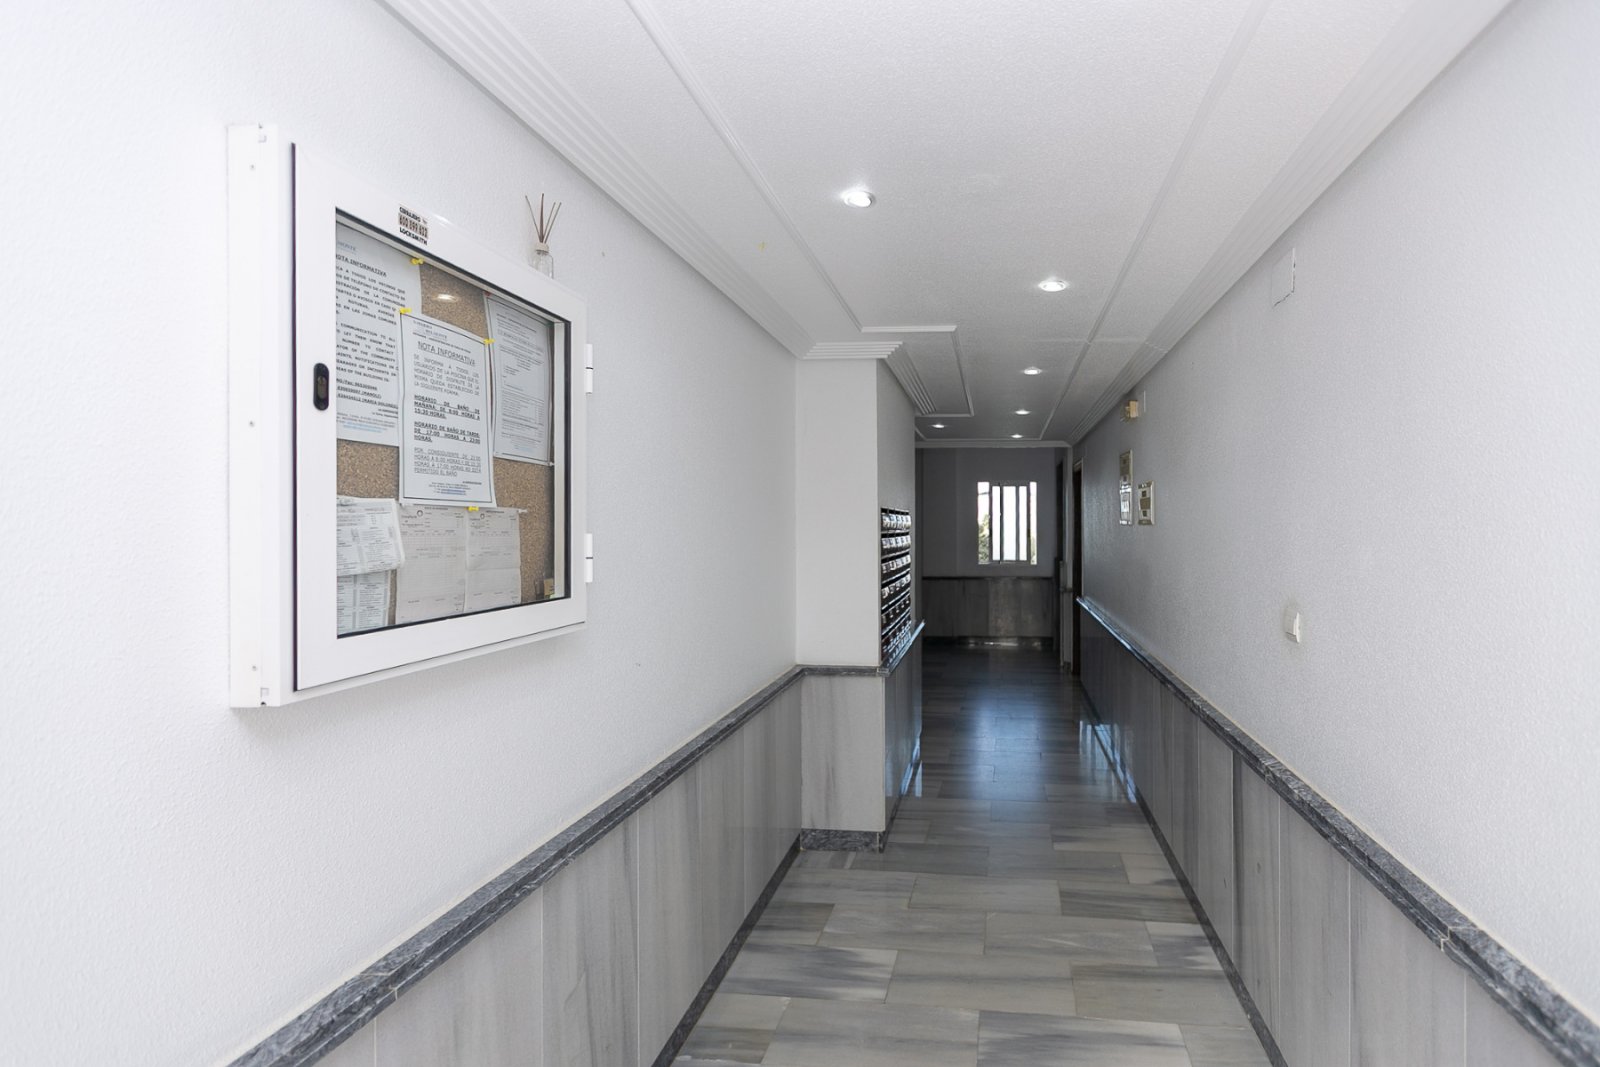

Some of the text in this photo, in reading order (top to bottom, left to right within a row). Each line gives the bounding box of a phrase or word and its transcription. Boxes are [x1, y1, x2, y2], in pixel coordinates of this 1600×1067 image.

[400, 227, 428, 246] LOCKSMITH
[351, 259, 386, 278] INFORMATIVA
[418, 340, 436, 354] NOTA
[438, 347, 475, 367] INFORMATIVA
[414, 368, 433, 378] HORARIO
[446, 377, 465, 386] DISFRUTE
[430, 379, 445, 388] QUEDA
[448, 383, 473, 394] ESTABLECIDO
[415, 395, 437, 405] HORARIO
[458, 403, 468, 412] BAÑO
[415, 421, 438, 430] HORARIO
[447, 426, 459, 434] BAÑO
